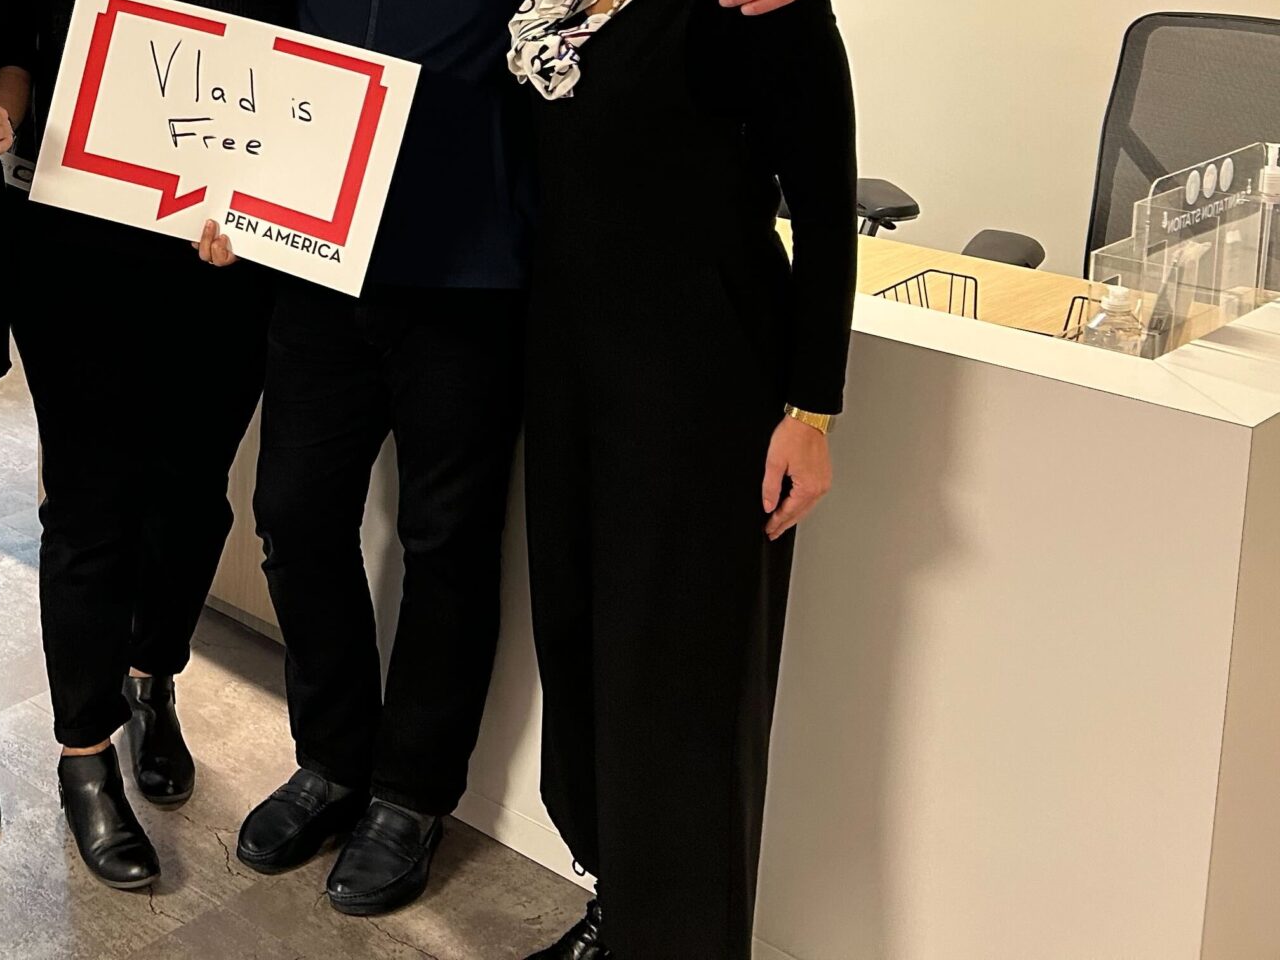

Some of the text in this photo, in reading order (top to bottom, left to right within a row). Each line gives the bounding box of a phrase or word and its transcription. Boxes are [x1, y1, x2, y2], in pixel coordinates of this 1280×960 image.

[150, 39, 313, 123] Vlad is
[167, 117, 262, 155] Free
[224, 210, 342, 264] PEN AMERICA
